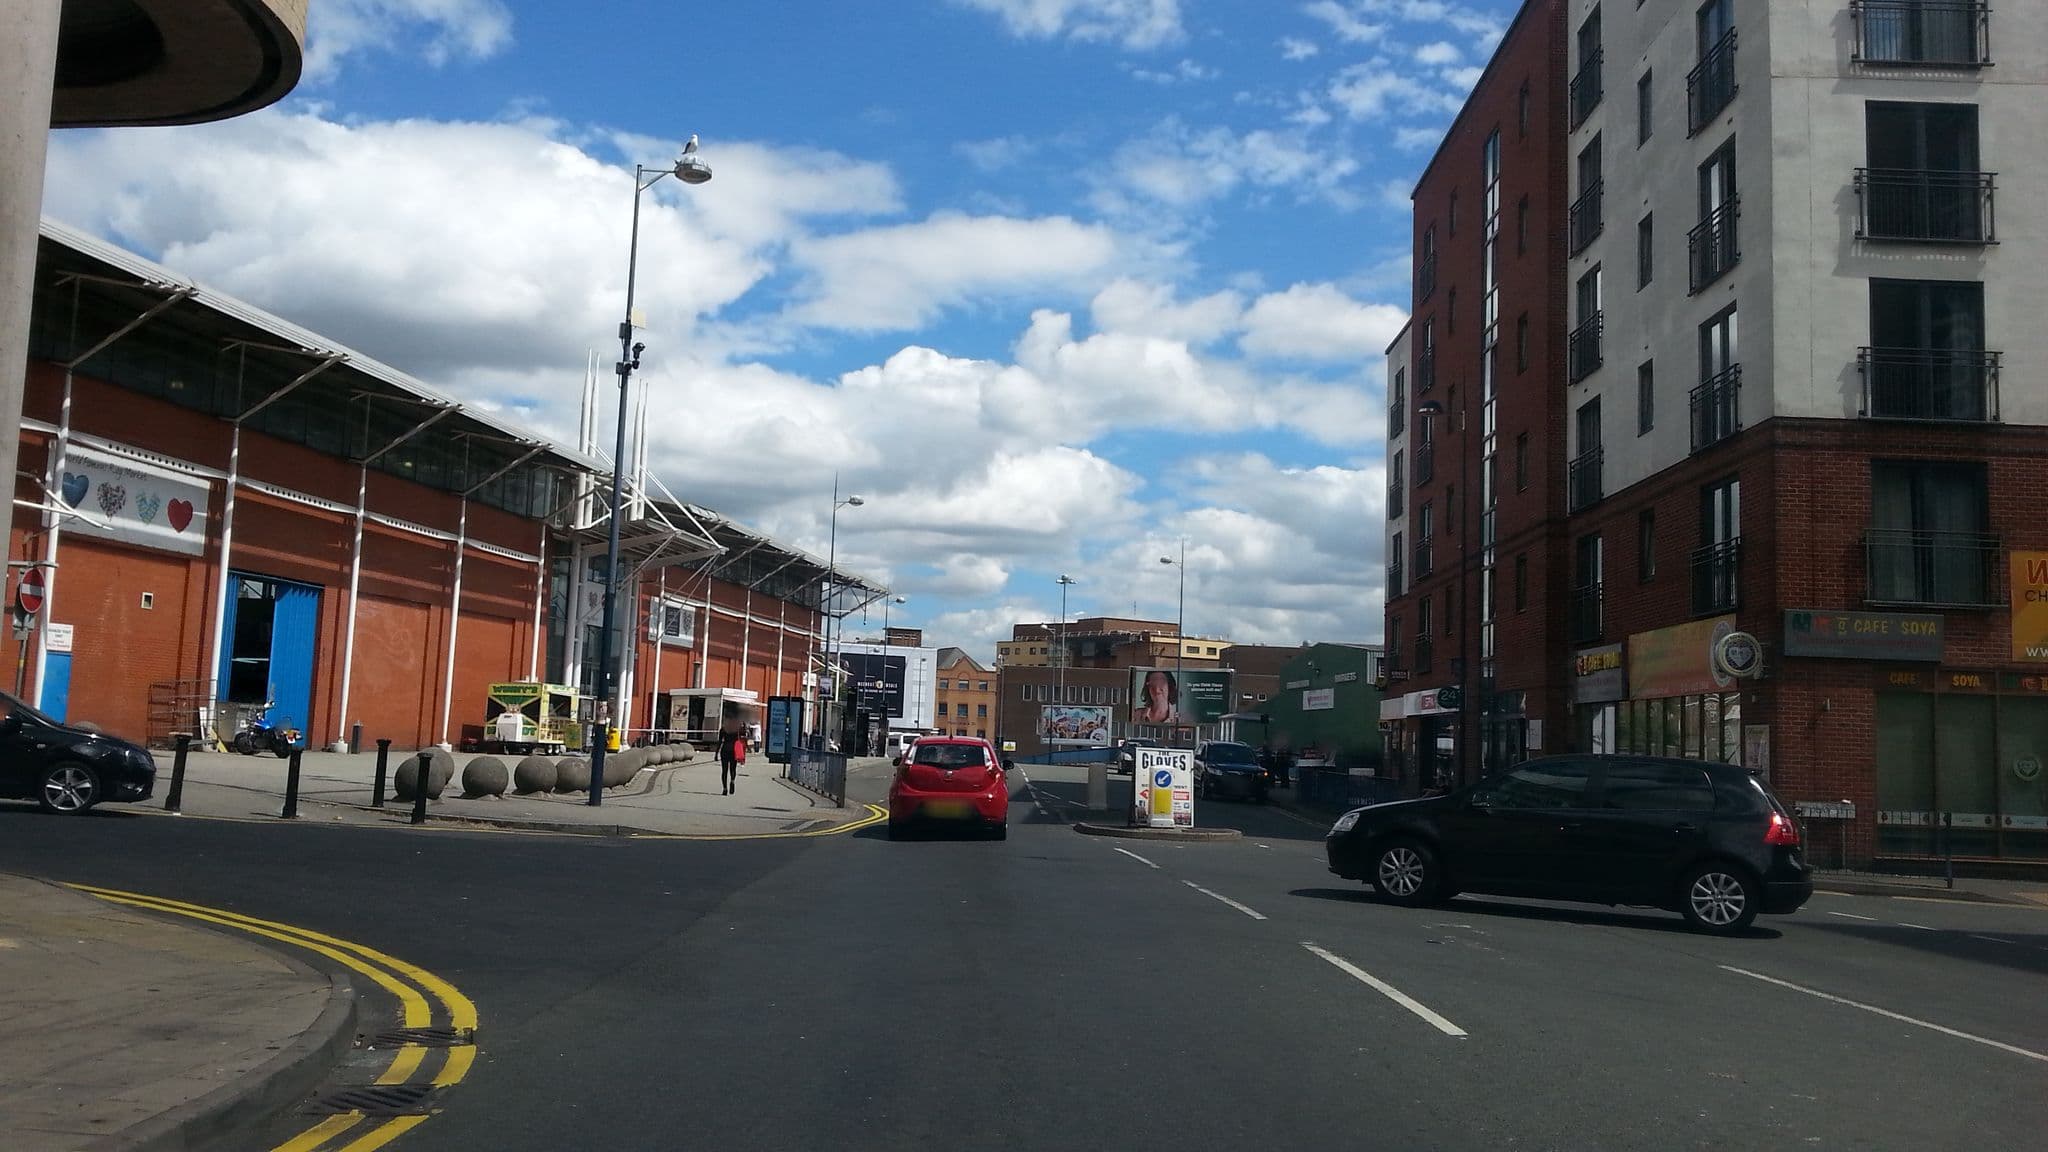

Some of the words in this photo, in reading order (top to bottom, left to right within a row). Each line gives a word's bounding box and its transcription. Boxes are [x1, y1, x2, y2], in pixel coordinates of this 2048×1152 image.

[1902, 620, 1937, 637] SOYA
[1952, 674, 1981, 688] SOYA
[1142, 752, 1187, 771] GLOVES
